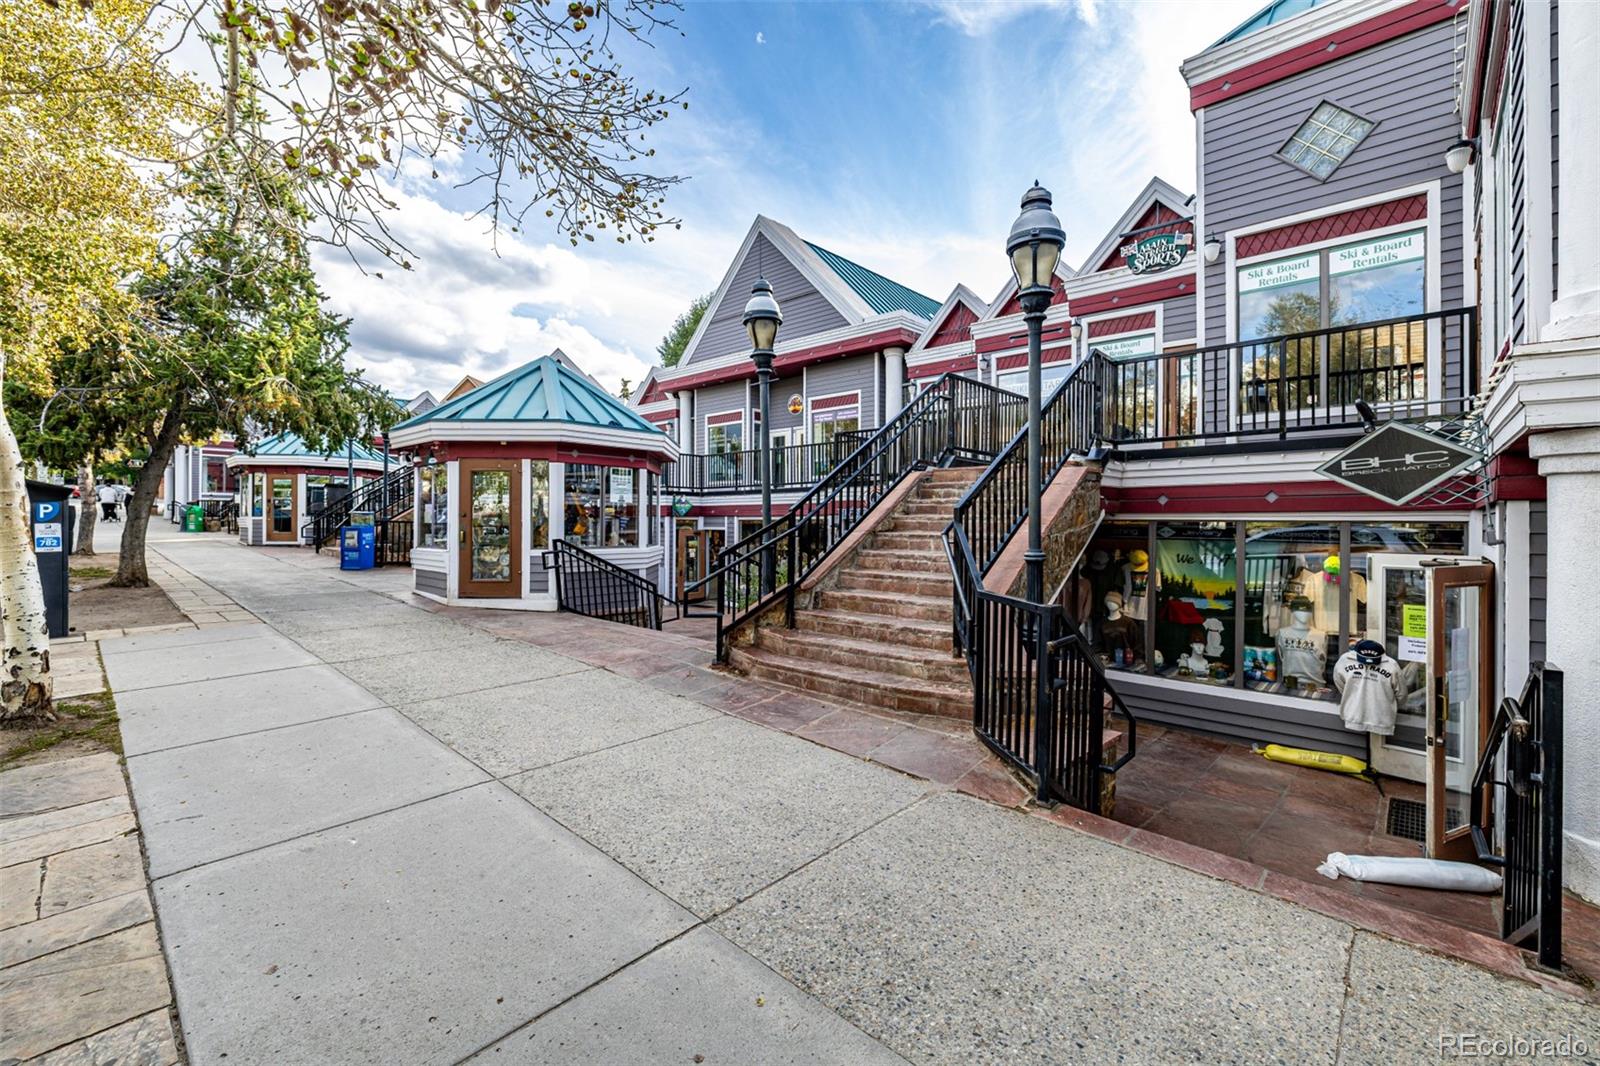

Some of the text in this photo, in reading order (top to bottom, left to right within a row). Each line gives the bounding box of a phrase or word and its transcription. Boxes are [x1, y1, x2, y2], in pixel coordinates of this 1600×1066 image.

[1140, 238, 1168, 253] MAIN
[1339, 237, 1412, 261] Ski & Board
[1352, 252, 1399, 269] Rentals
[1247, 259, 1310, 280] Ski & Board
[1258, 273, 1298, 287] Rentals
[1120, 340, 1141, 350] Board
[1394, 464, 1423, 472] HAT
[39, 503, 53, 518] P
[39, 539, 58, 547] 782
[1176, 553, 1194, 564] We
